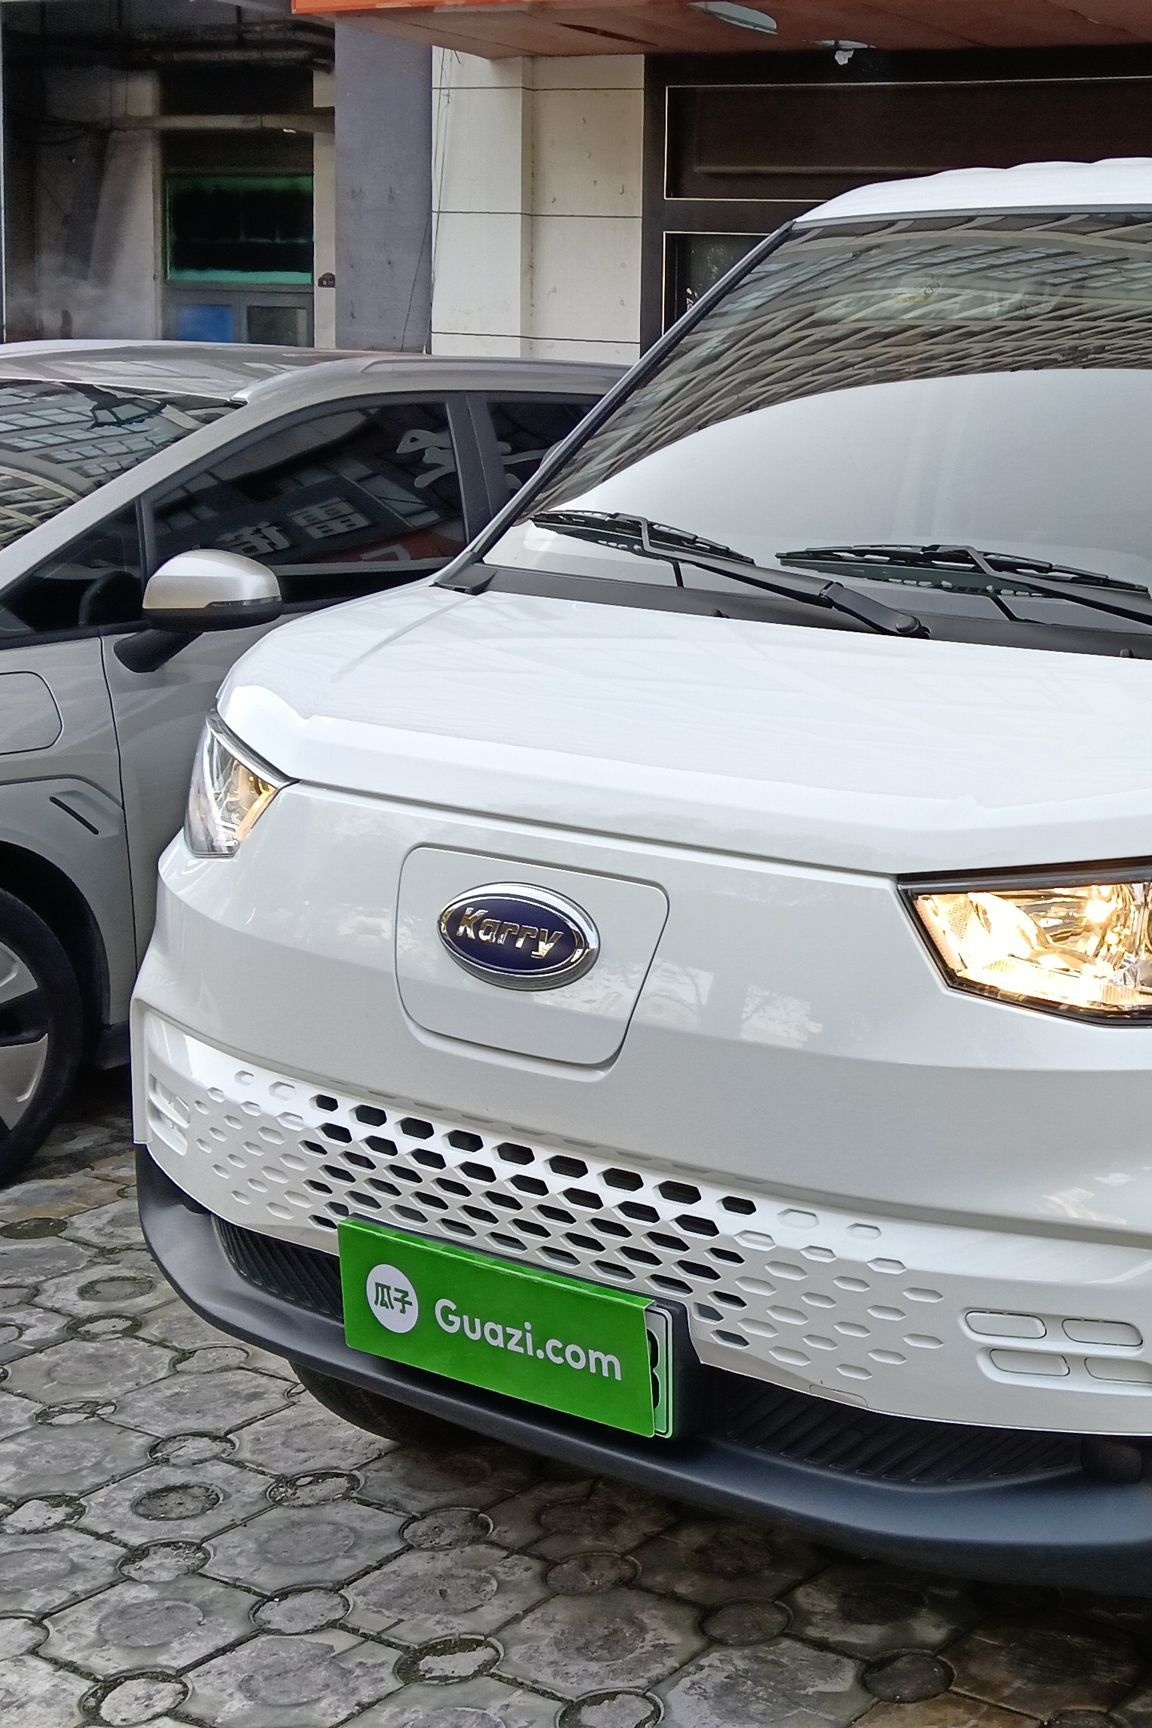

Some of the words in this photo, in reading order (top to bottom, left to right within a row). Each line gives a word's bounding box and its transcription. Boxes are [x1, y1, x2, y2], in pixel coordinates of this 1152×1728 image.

[455, 907, 564, 960] Karry
[373, 1281, 413, 1315] 瓜子
[434, 1297, 623, 1382] Guazi.com
